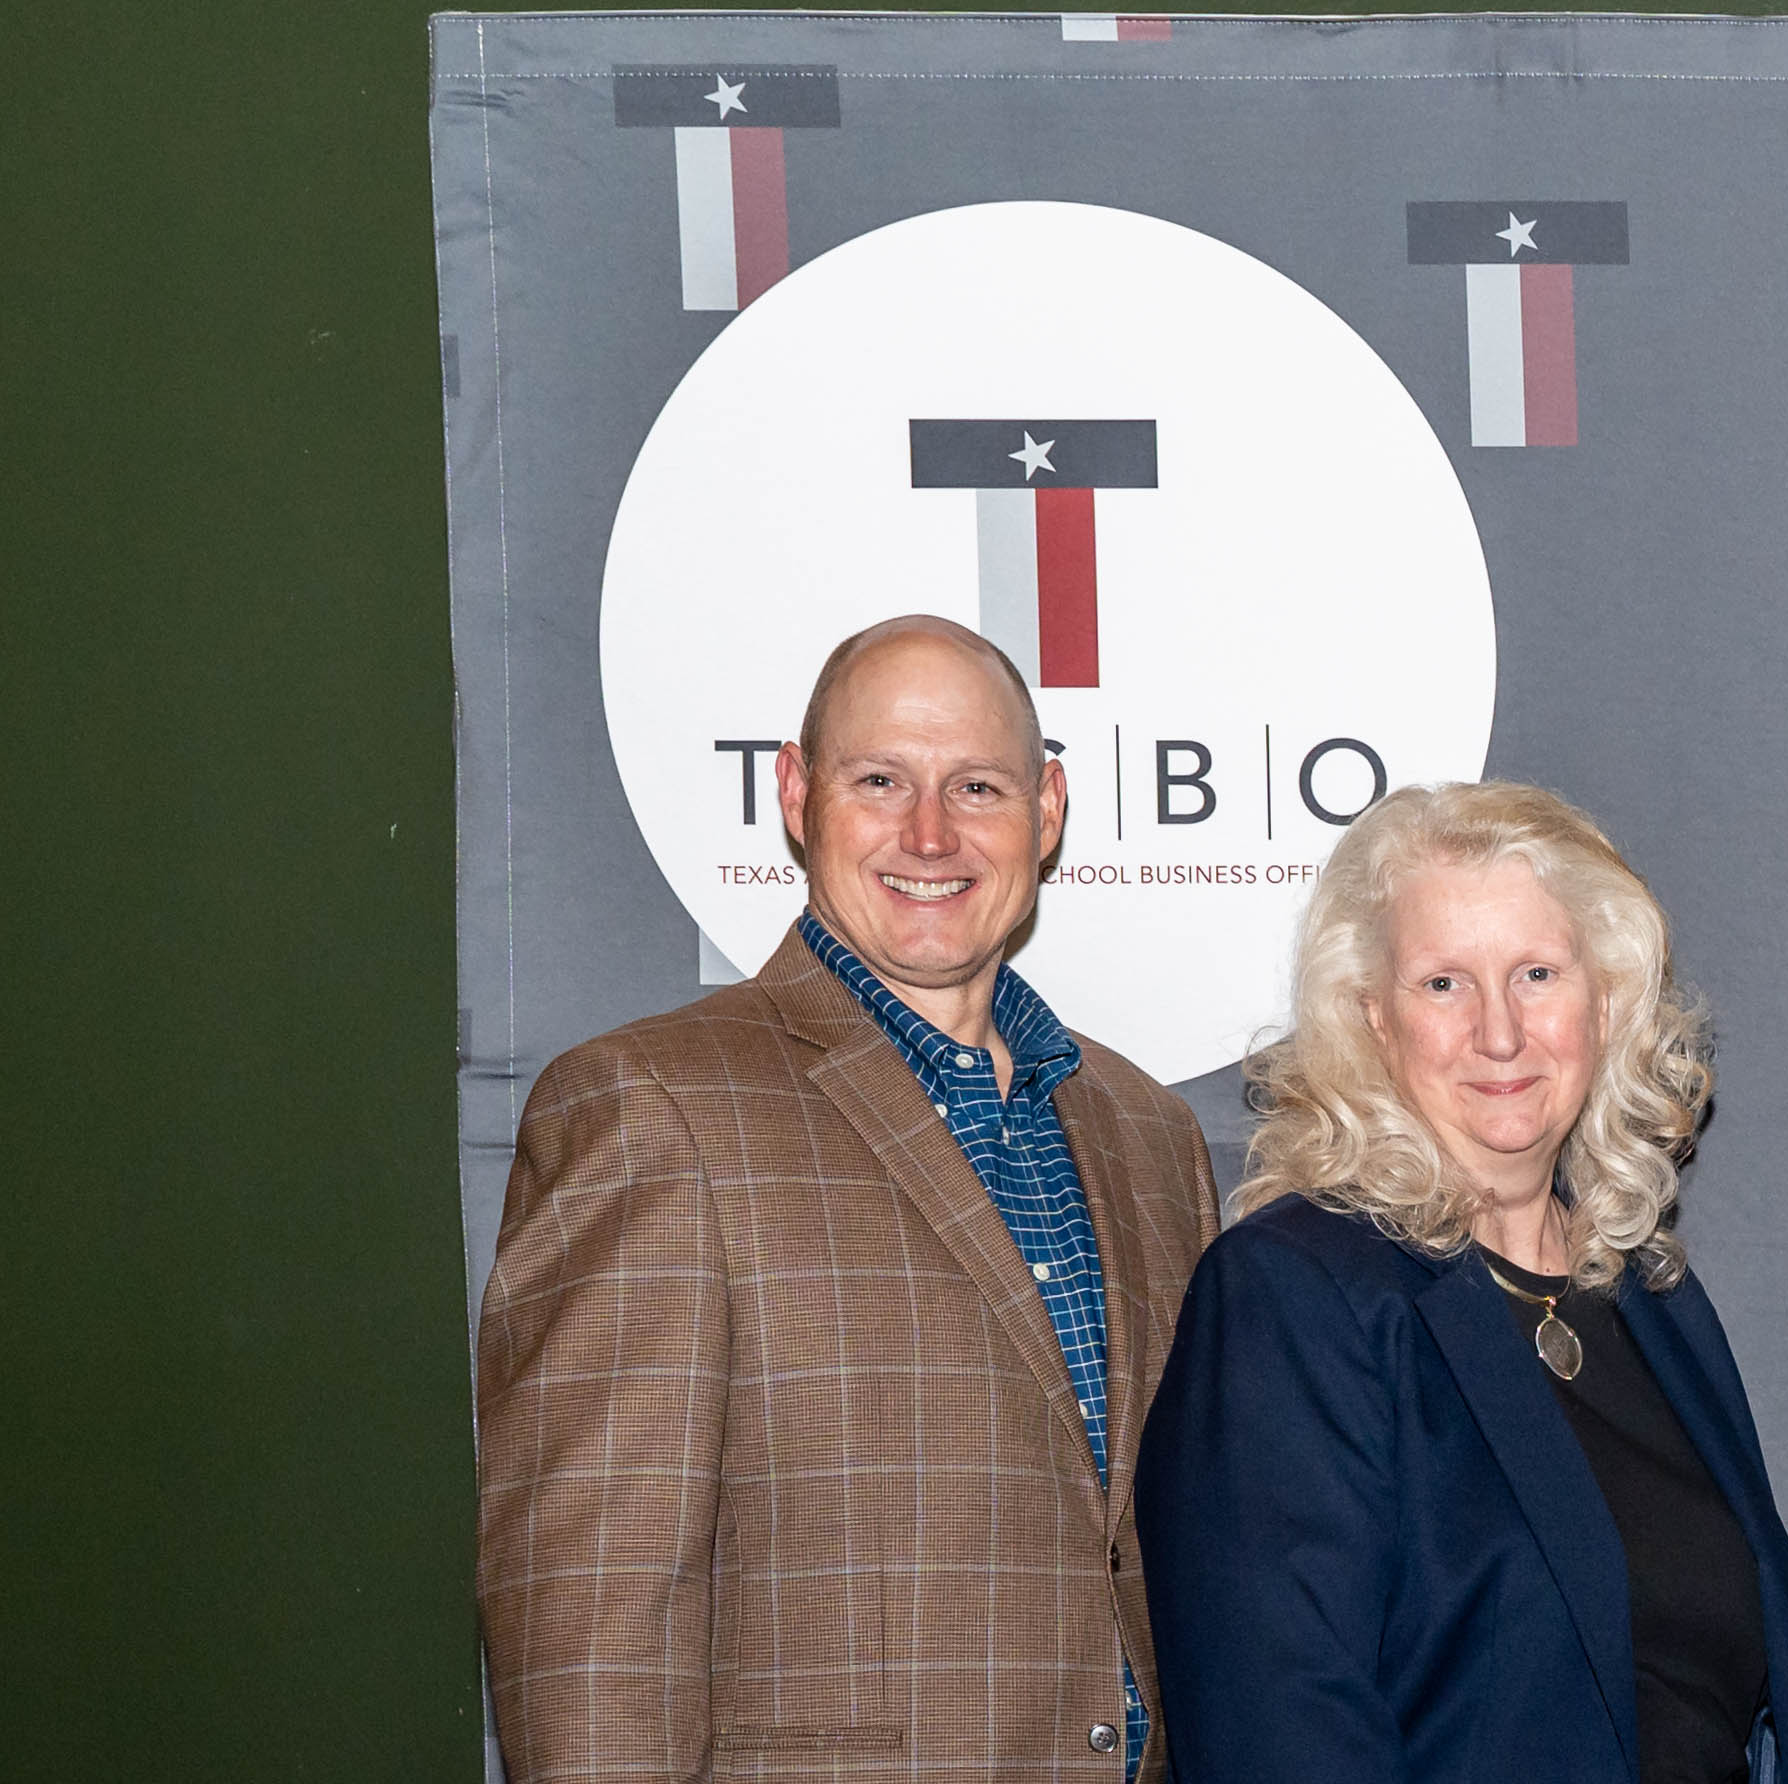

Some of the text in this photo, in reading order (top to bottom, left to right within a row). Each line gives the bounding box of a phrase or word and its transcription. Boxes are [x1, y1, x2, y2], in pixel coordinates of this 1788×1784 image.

[717, 865, 796, 885] TEXAS
[1040, 864, 1132, 884] CHOOL
[1140, 864, 1257, 884] BUSINESS
